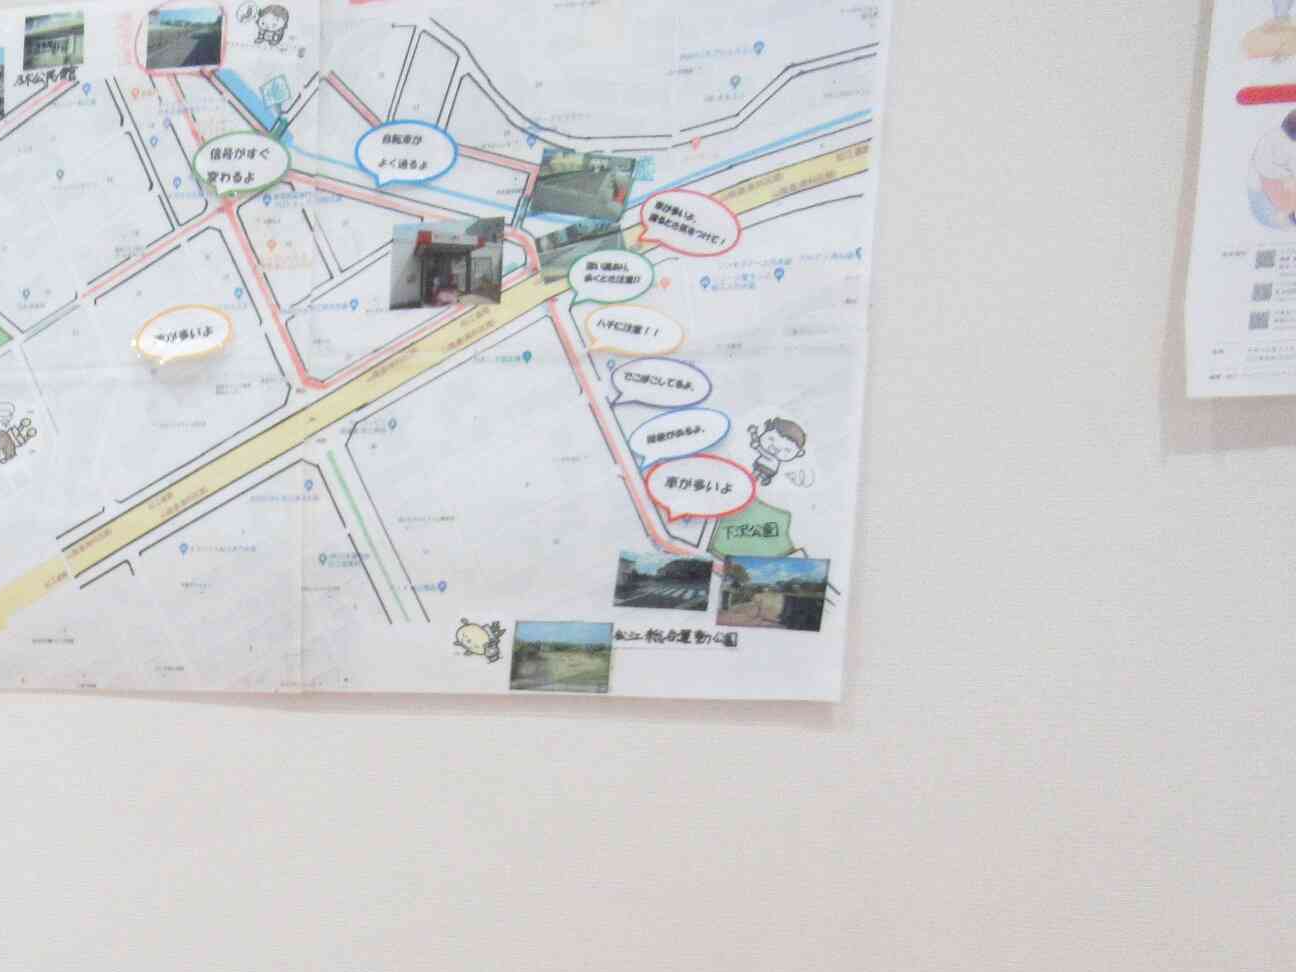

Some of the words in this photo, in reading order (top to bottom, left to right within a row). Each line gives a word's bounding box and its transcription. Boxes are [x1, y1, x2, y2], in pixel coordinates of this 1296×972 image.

[382, 134, 423, 146] 自転車が
[210, 147, 271, 160] 信号がすぐ
[207, 171, 255, 184] 変わるよ
[664, 475, 734, 495] 車が多いよ
